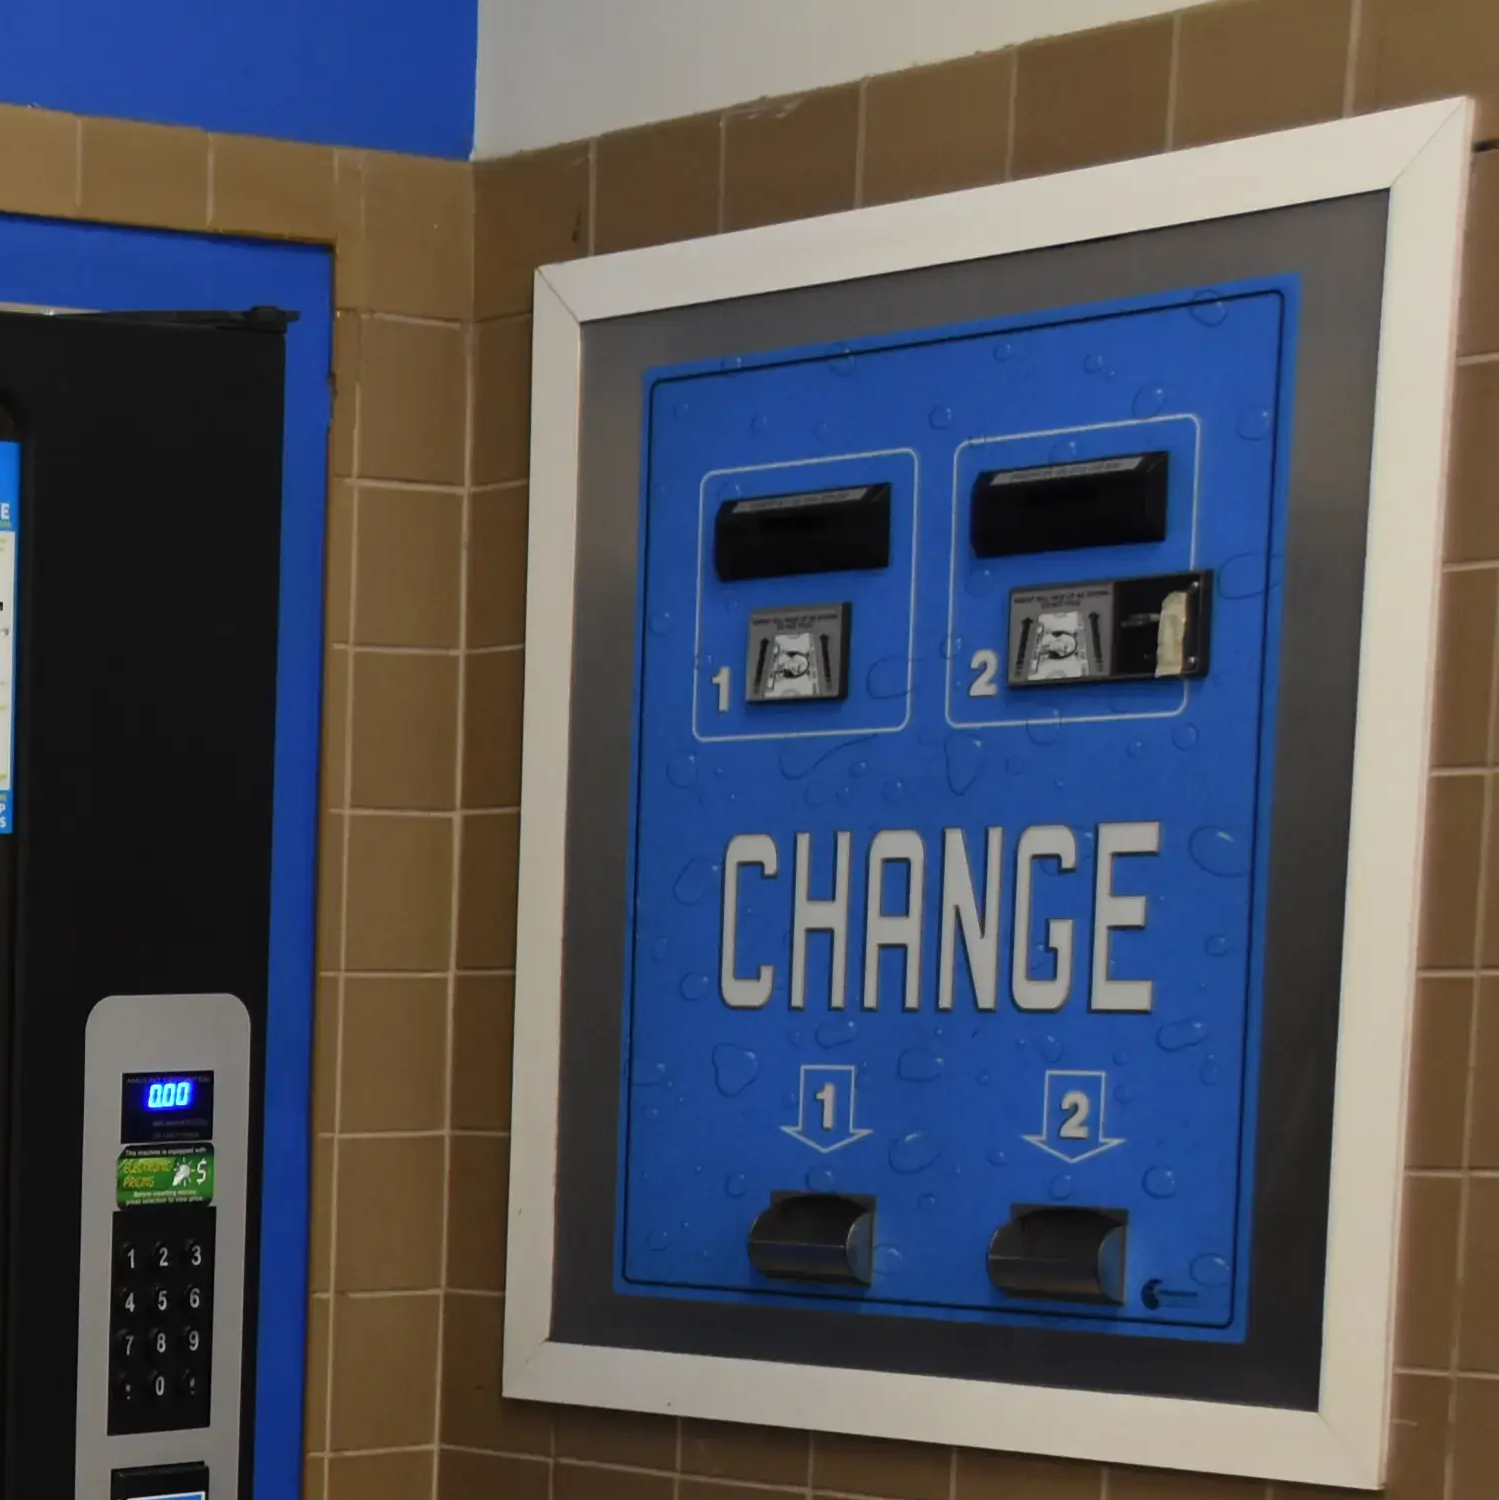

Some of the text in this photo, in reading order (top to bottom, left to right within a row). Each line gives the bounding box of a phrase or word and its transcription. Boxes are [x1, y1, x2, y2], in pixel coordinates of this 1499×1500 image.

[969, 649, 998, 697] 2
[711, 667, 731, 712] 1
[718, 819, 1163, 1012] CHANGE
[817, 1082, 838, 1131] 1
[1060, 1091, 1091, 1140] 2
[127, 1248, 135, 1269] 1
[158, 1247, 169, 1267] 2
[191, 1245, 202, 1266] 3
[124, 1292, 135, 1312] 4
[157, 1290, 168, 1311] 5
[189, 1287, 200, 1308] 6
[125, 1335, 134, 1356] 7
[156, 1332, 166, 1353] 8
[188, 1330, 200, 1351] 9
[155, 1375, 165, 1396] 0
